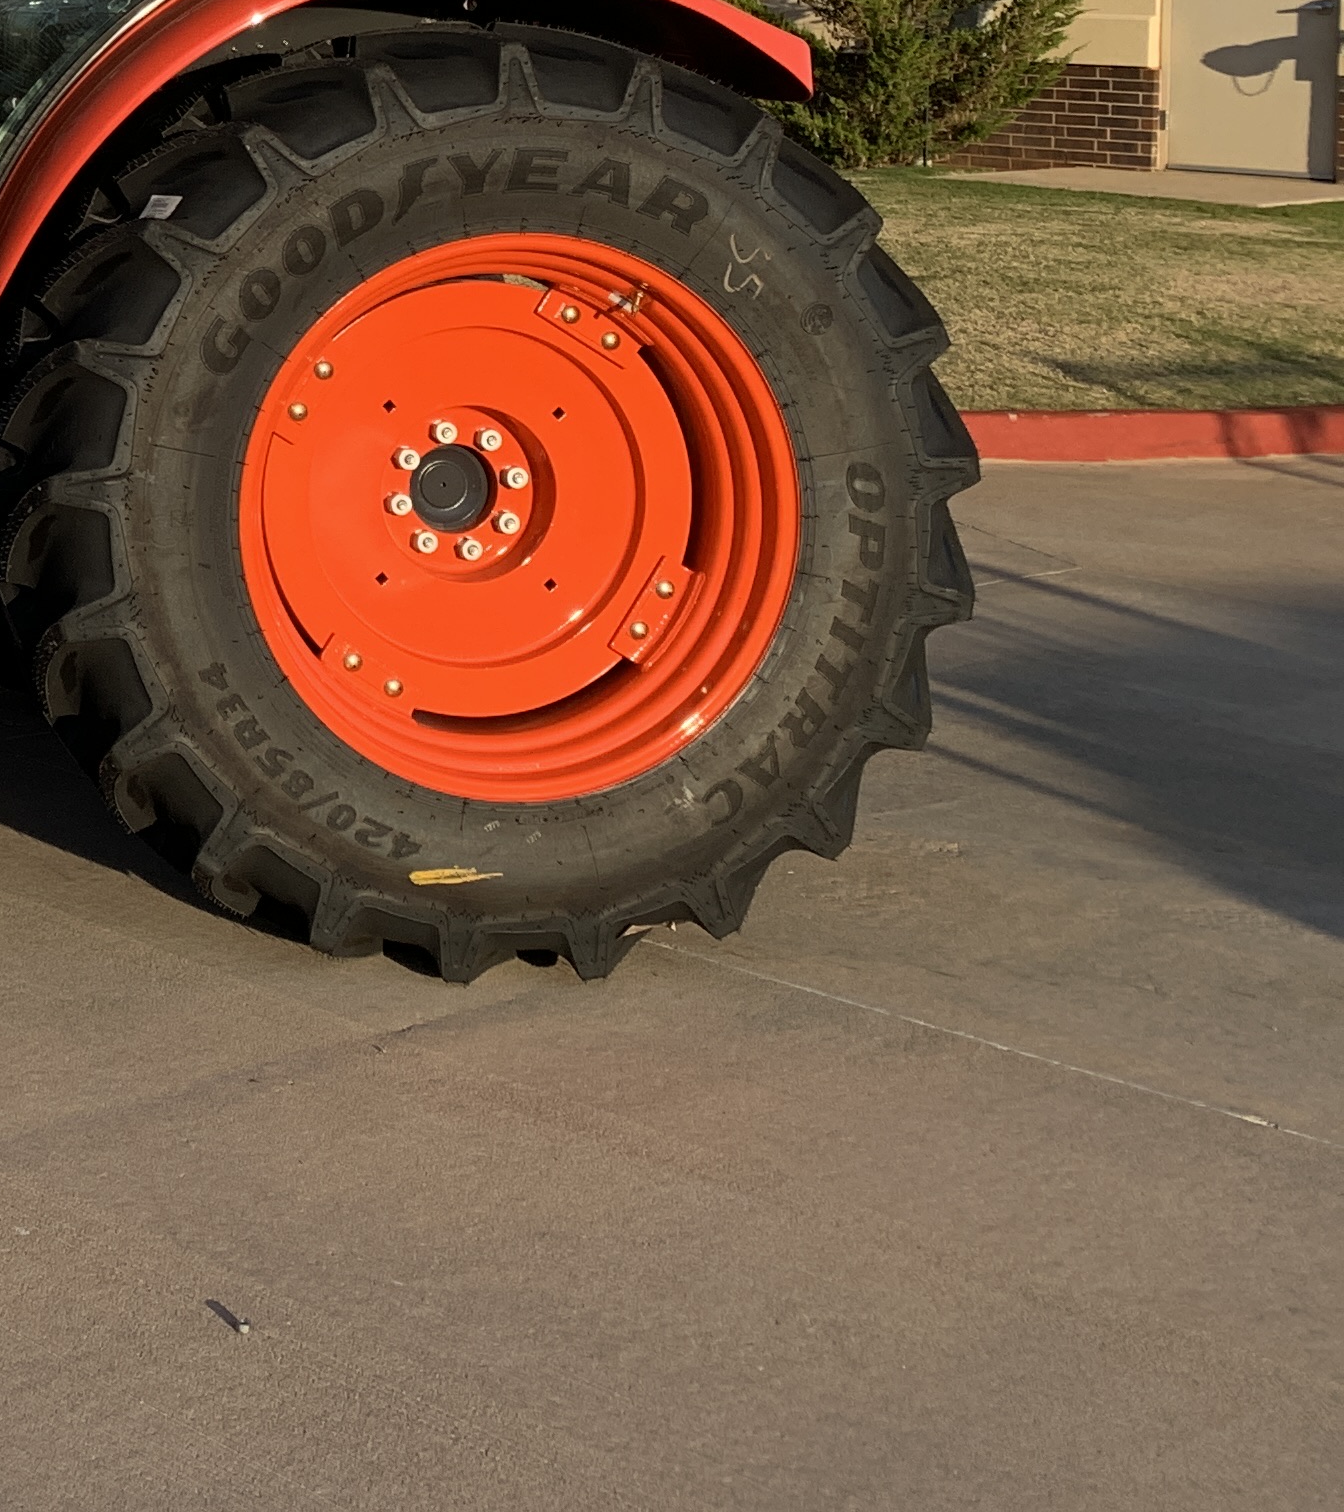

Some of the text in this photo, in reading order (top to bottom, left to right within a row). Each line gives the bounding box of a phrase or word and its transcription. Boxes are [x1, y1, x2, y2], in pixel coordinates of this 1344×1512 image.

[201, 147, 709, 376] GOODYEAR
[702, 461, 886, 825] OPTITRAC
[198, 662, 423, 860] 420/85R34
